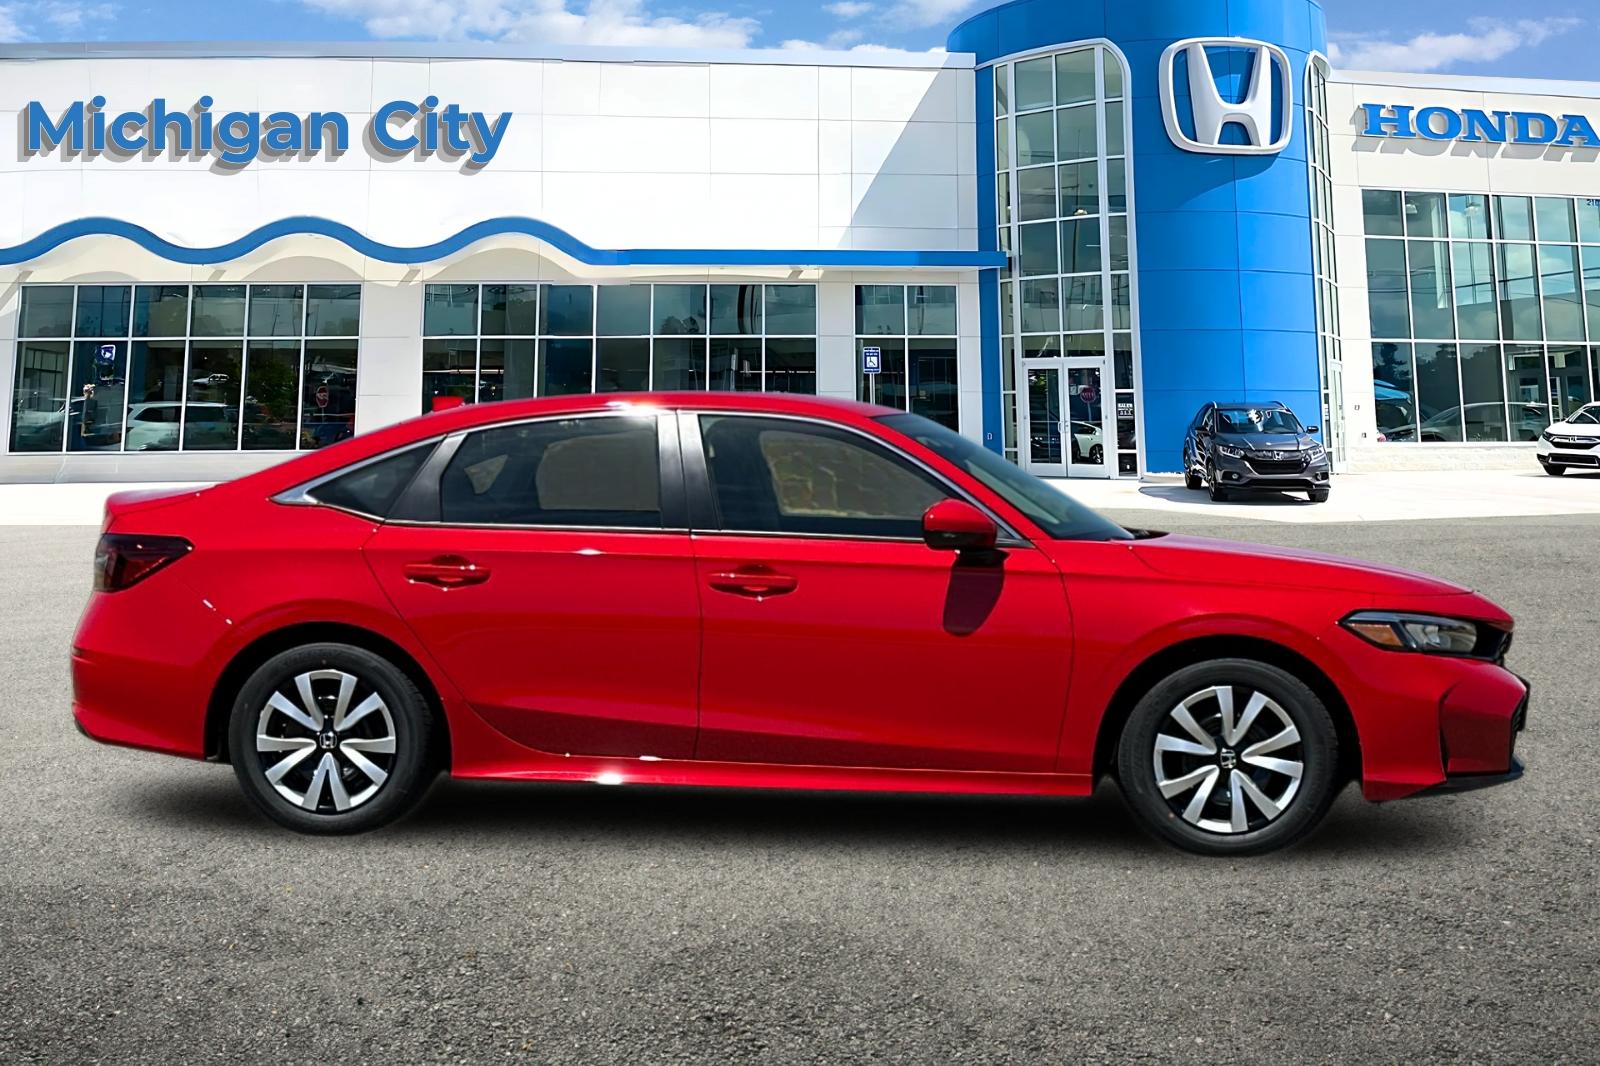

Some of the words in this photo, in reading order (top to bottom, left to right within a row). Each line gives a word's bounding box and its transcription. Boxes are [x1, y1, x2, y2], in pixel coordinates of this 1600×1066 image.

[29, 95, 349, 164] Michigan
[373, 95, 513, 164] City
[1362, 103, 1600, 148] HONDA
